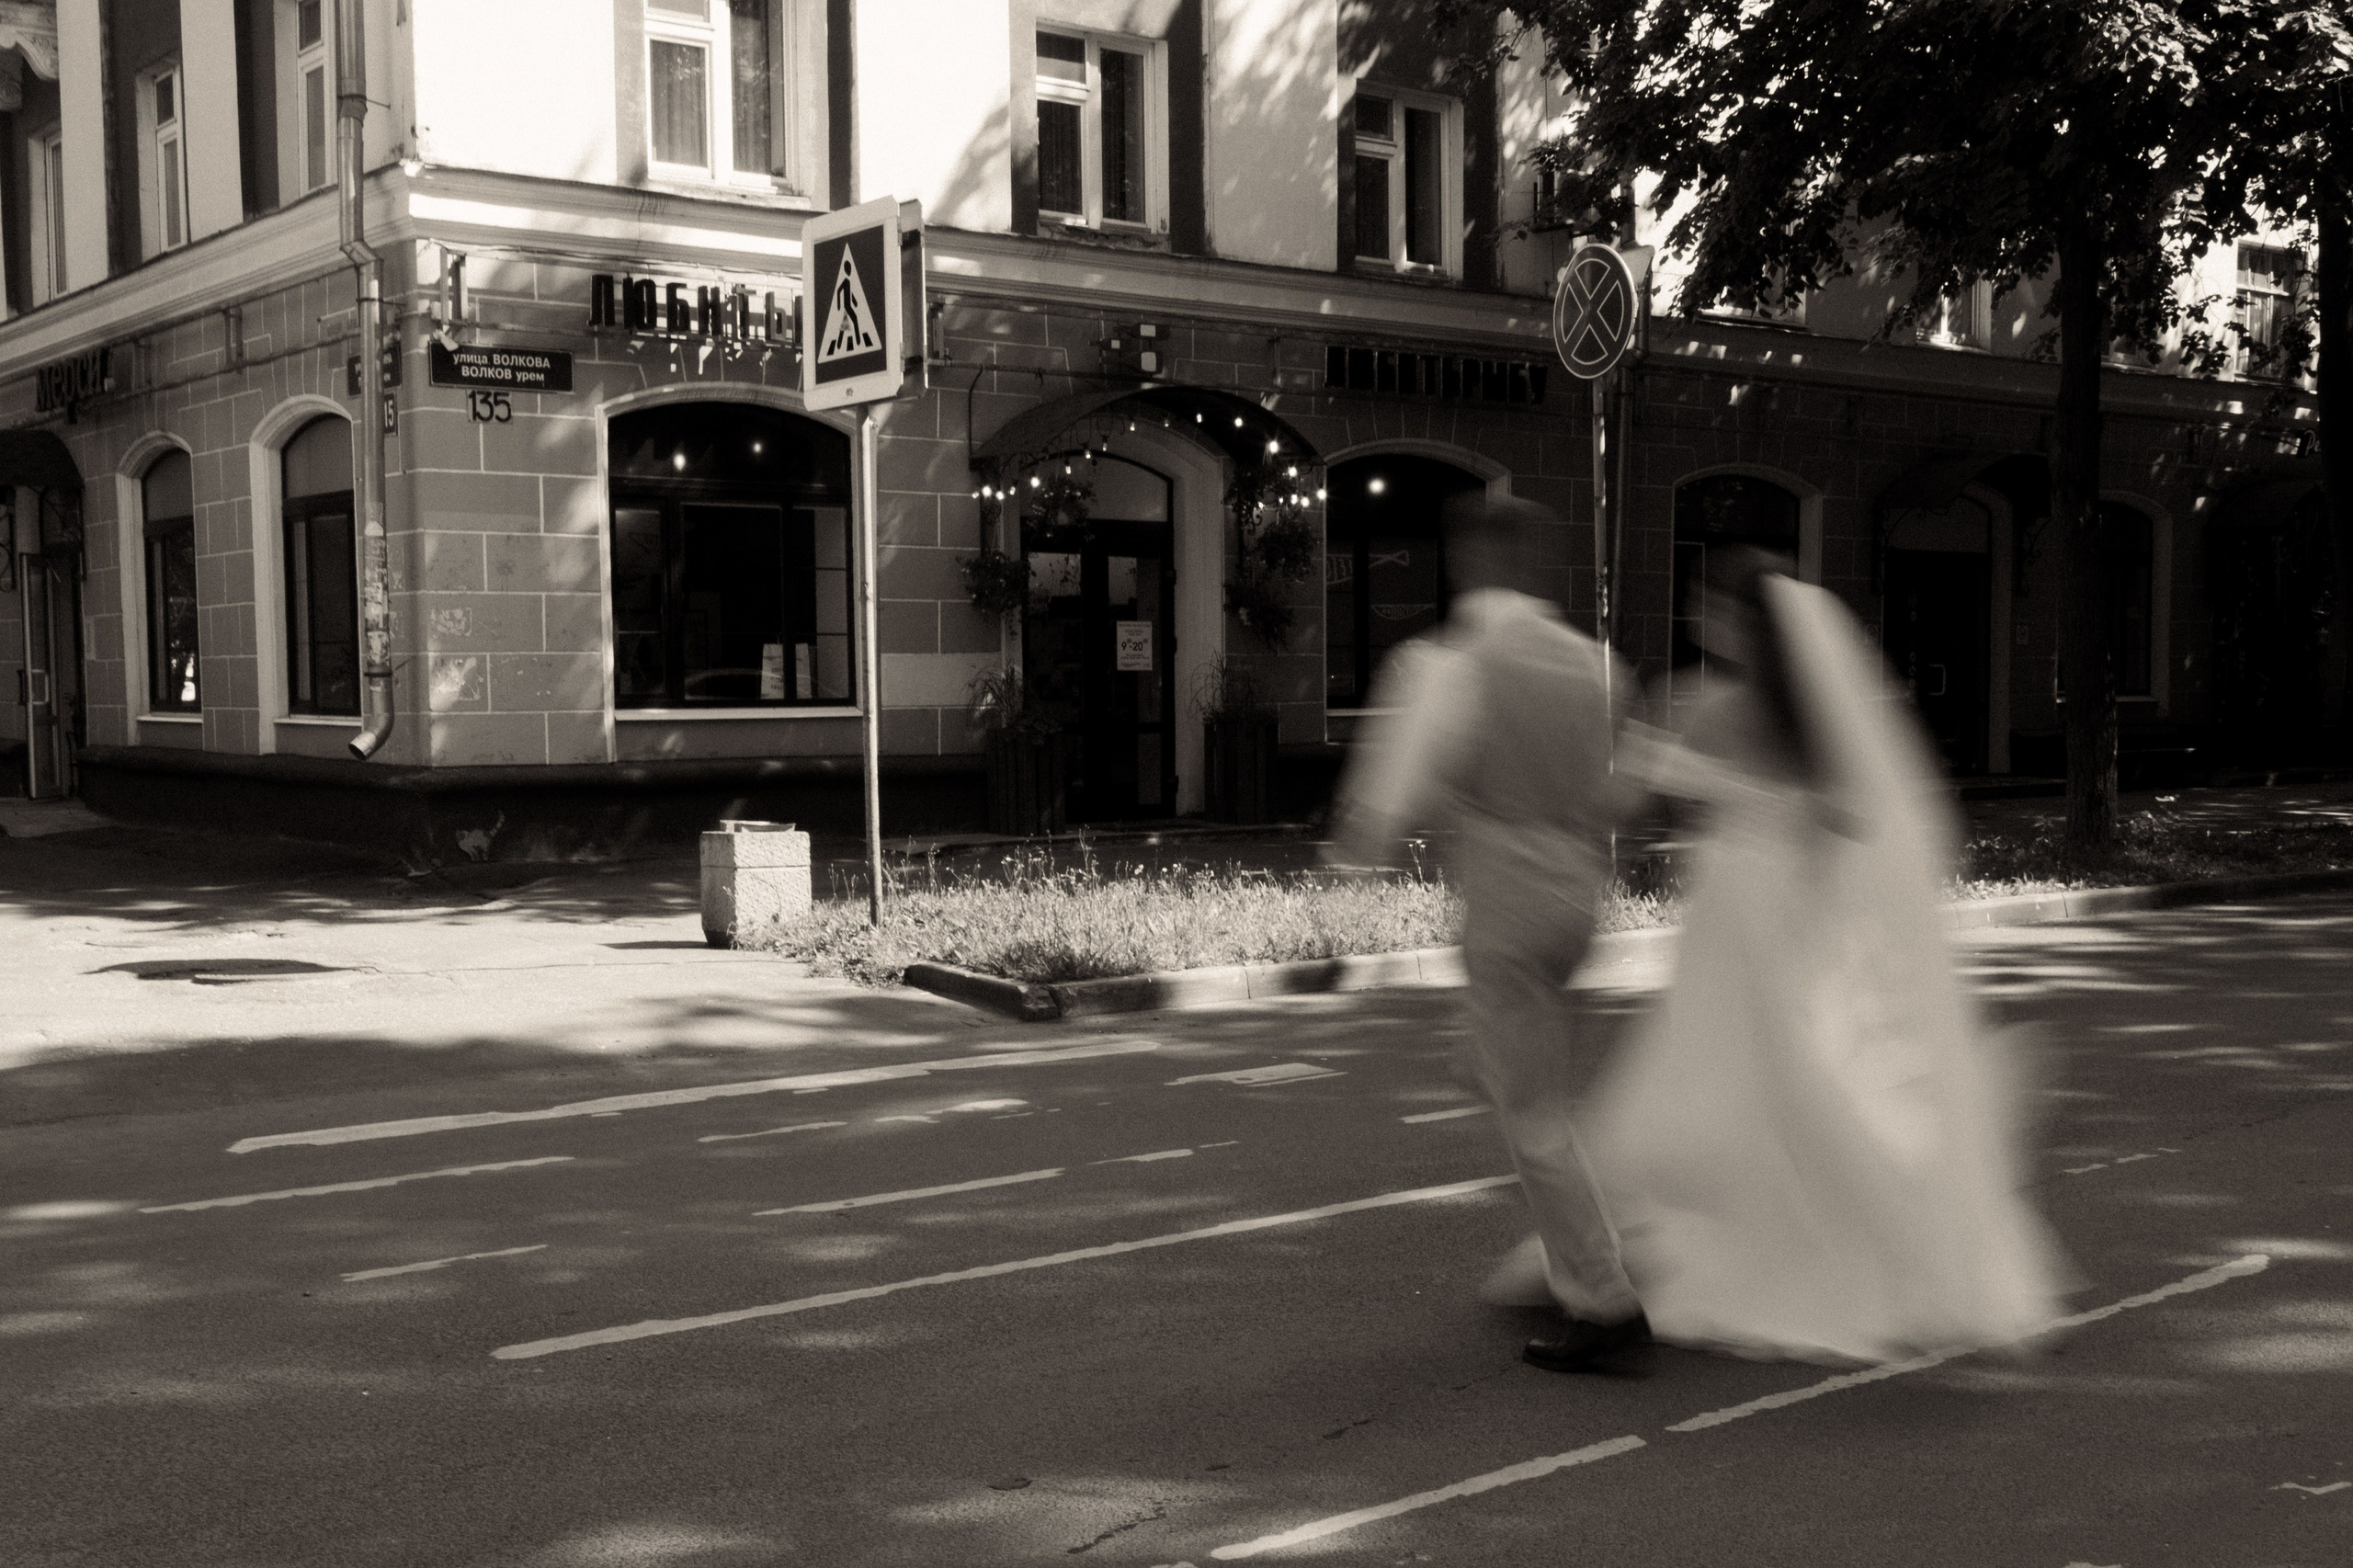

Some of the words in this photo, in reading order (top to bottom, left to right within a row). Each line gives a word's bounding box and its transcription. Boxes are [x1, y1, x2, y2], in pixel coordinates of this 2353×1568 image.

[586, 274, 802, 345] ЛЮБИТЬ
[453, 354, 488, 366] улица
[493, 354, 551, 369] ВОЛКОВА
[461, 365, 512, 380] ВОЛКОВ
[516, 371, 544, 382] урем
[468, 391, 512, 423] 135
